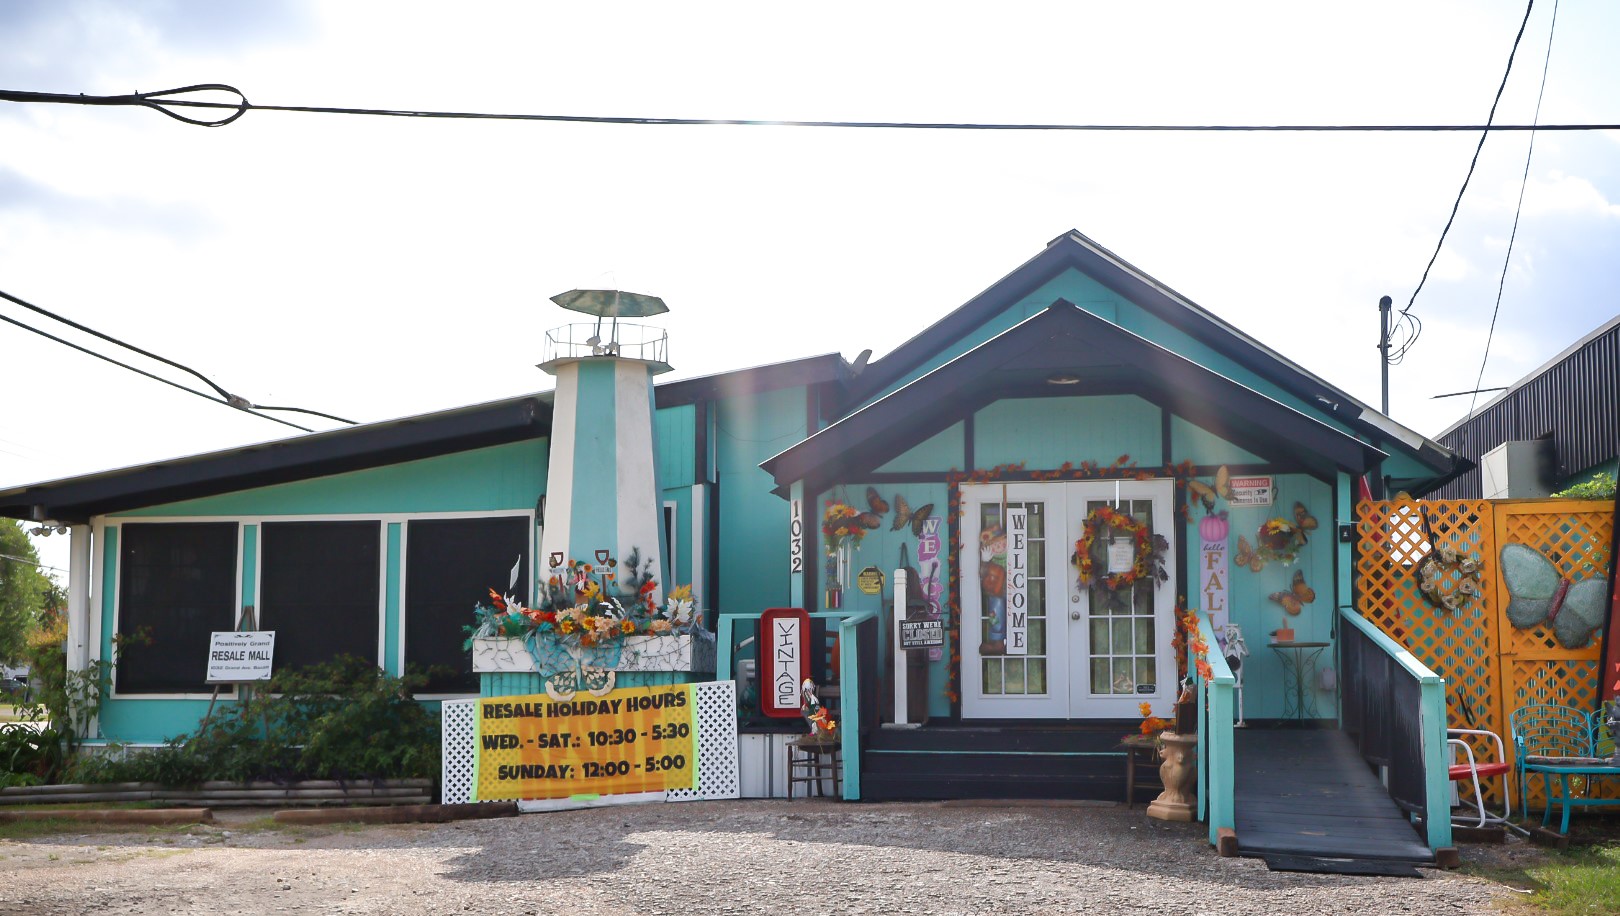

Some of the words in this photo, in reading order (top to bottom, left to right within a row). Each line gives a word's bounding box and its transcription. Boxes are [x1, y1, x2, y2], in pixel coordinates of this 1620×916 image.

[1231, 479, 1268, 487] WARNING
[791, 500, 802, 574] 1032
[1012, 514, 1026, 648] WELCOME
[1205, 551, 1224, 632] FALL
[902, 622, 922, 630] SORRY
[902, 628, 943, 640] CLOSED
[211, 650, 246, 661] RESALE
[248, 650, 270, 661] MALL
[776, 622, 795, 706] VINTAGE
[483, 702, 543, 719] RESALE
[547, 698, 623, 718] HOLIDAY
[626, 691, 687, 712] HOURS
[482, 734, 524, 750] WED.
[588, 728, 637, 747] 10:30
[651, 722, 690, 741] 5:30
[498, 763, 575, 780] SUNDAY:
[582, 760, 630, 778] 12:00
[645, 754, 686, 772] 5:00
